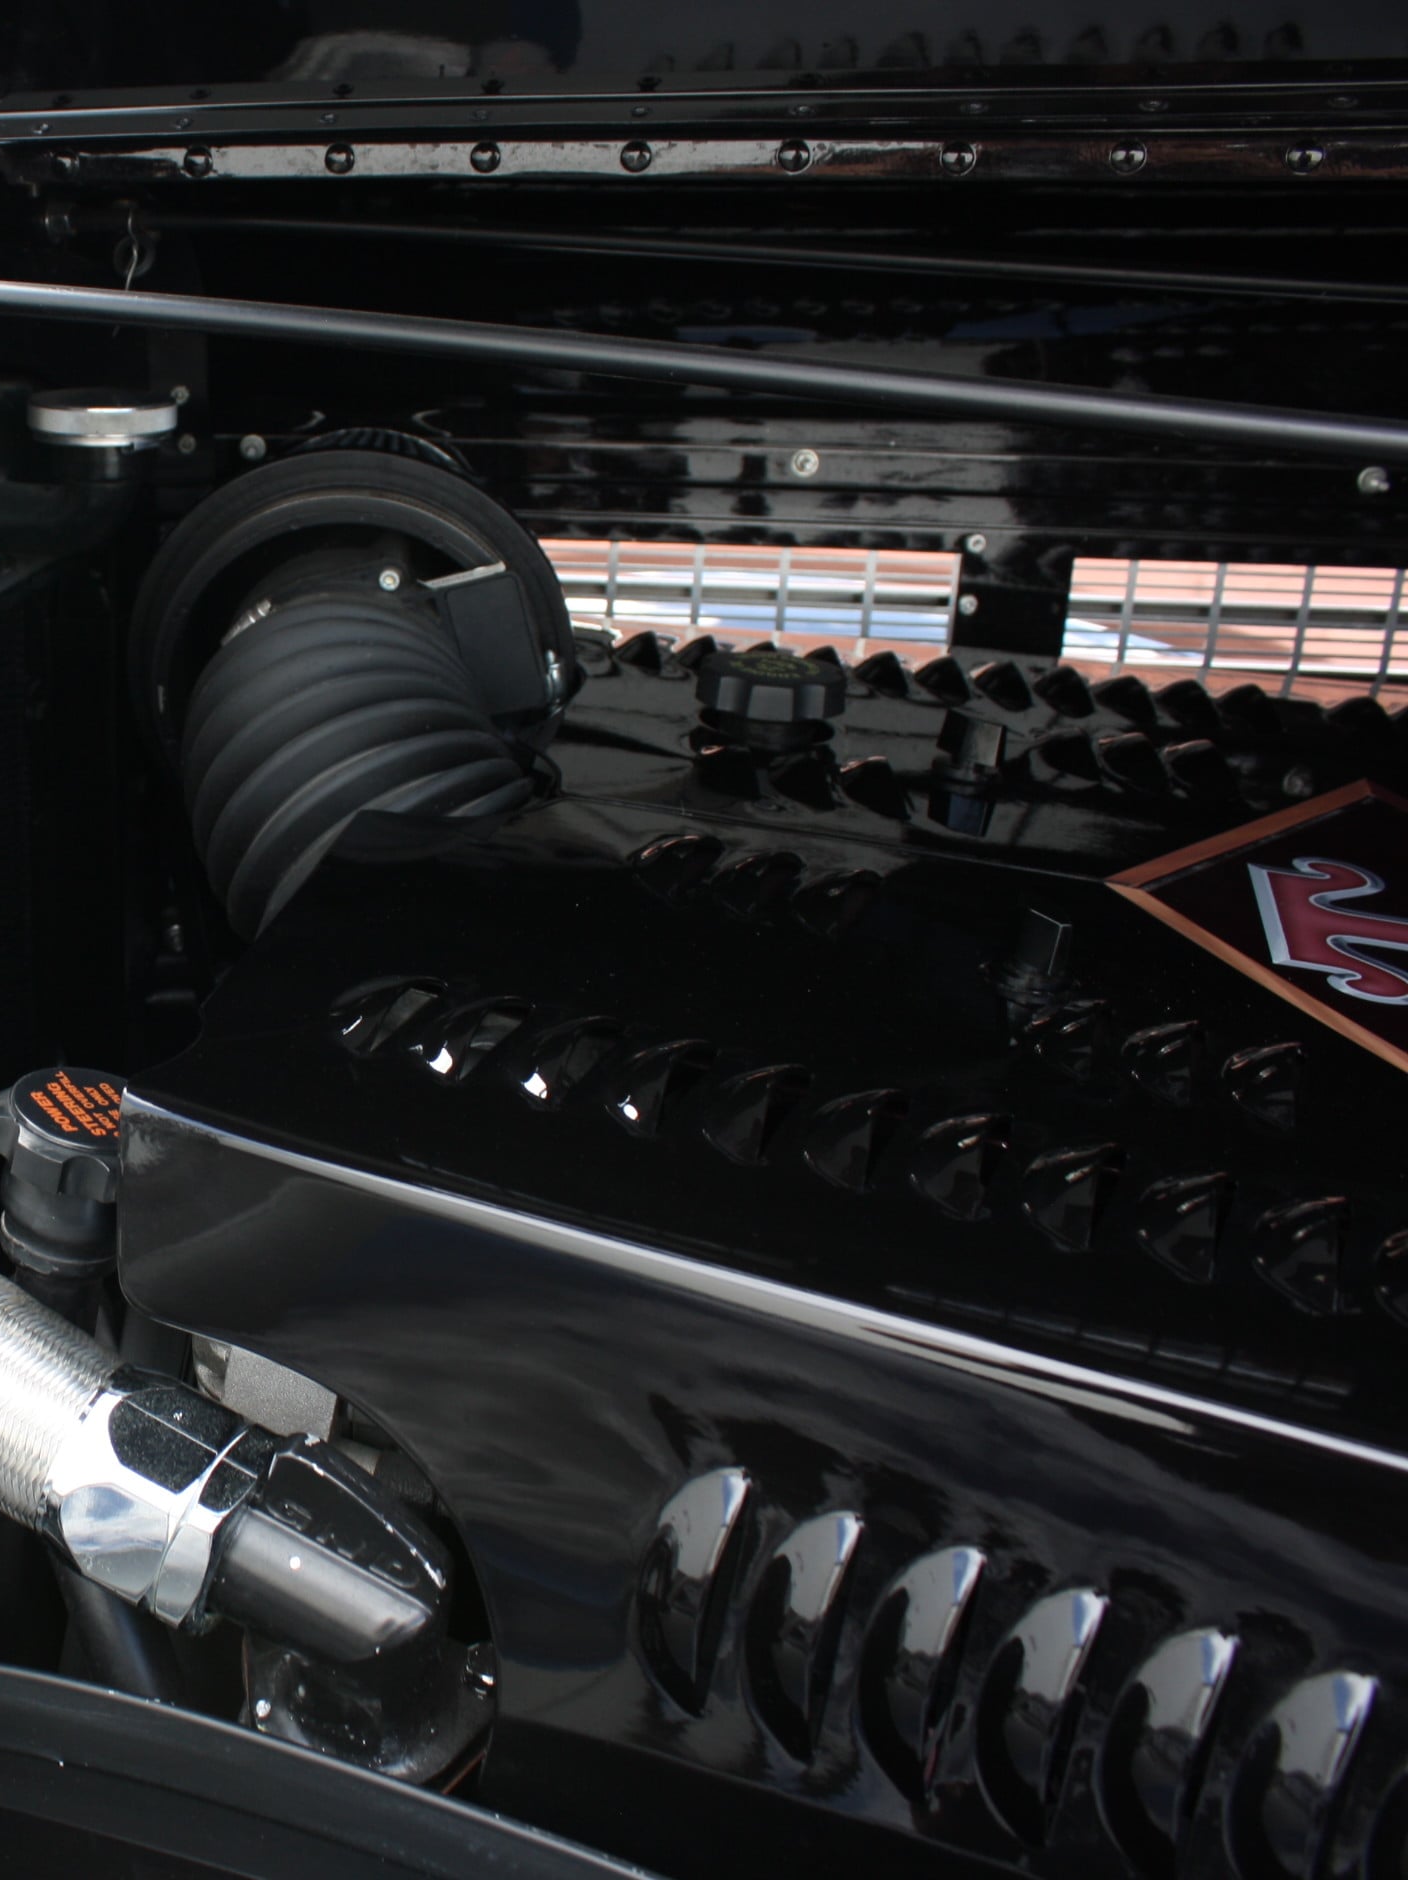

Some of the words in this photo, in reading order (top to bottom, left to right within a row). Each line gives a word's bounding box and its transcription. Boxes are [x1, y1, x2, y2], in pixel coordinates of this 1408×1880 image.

[56, 1071, 94, 1109] OVERFILL
[84, 1087, 109, 1106] ONLY
[31, 1091, 78, 1133] POWER
[47, 1083, 107, 1137] STEERING
[93, 1113, 117, 1130] NOT
